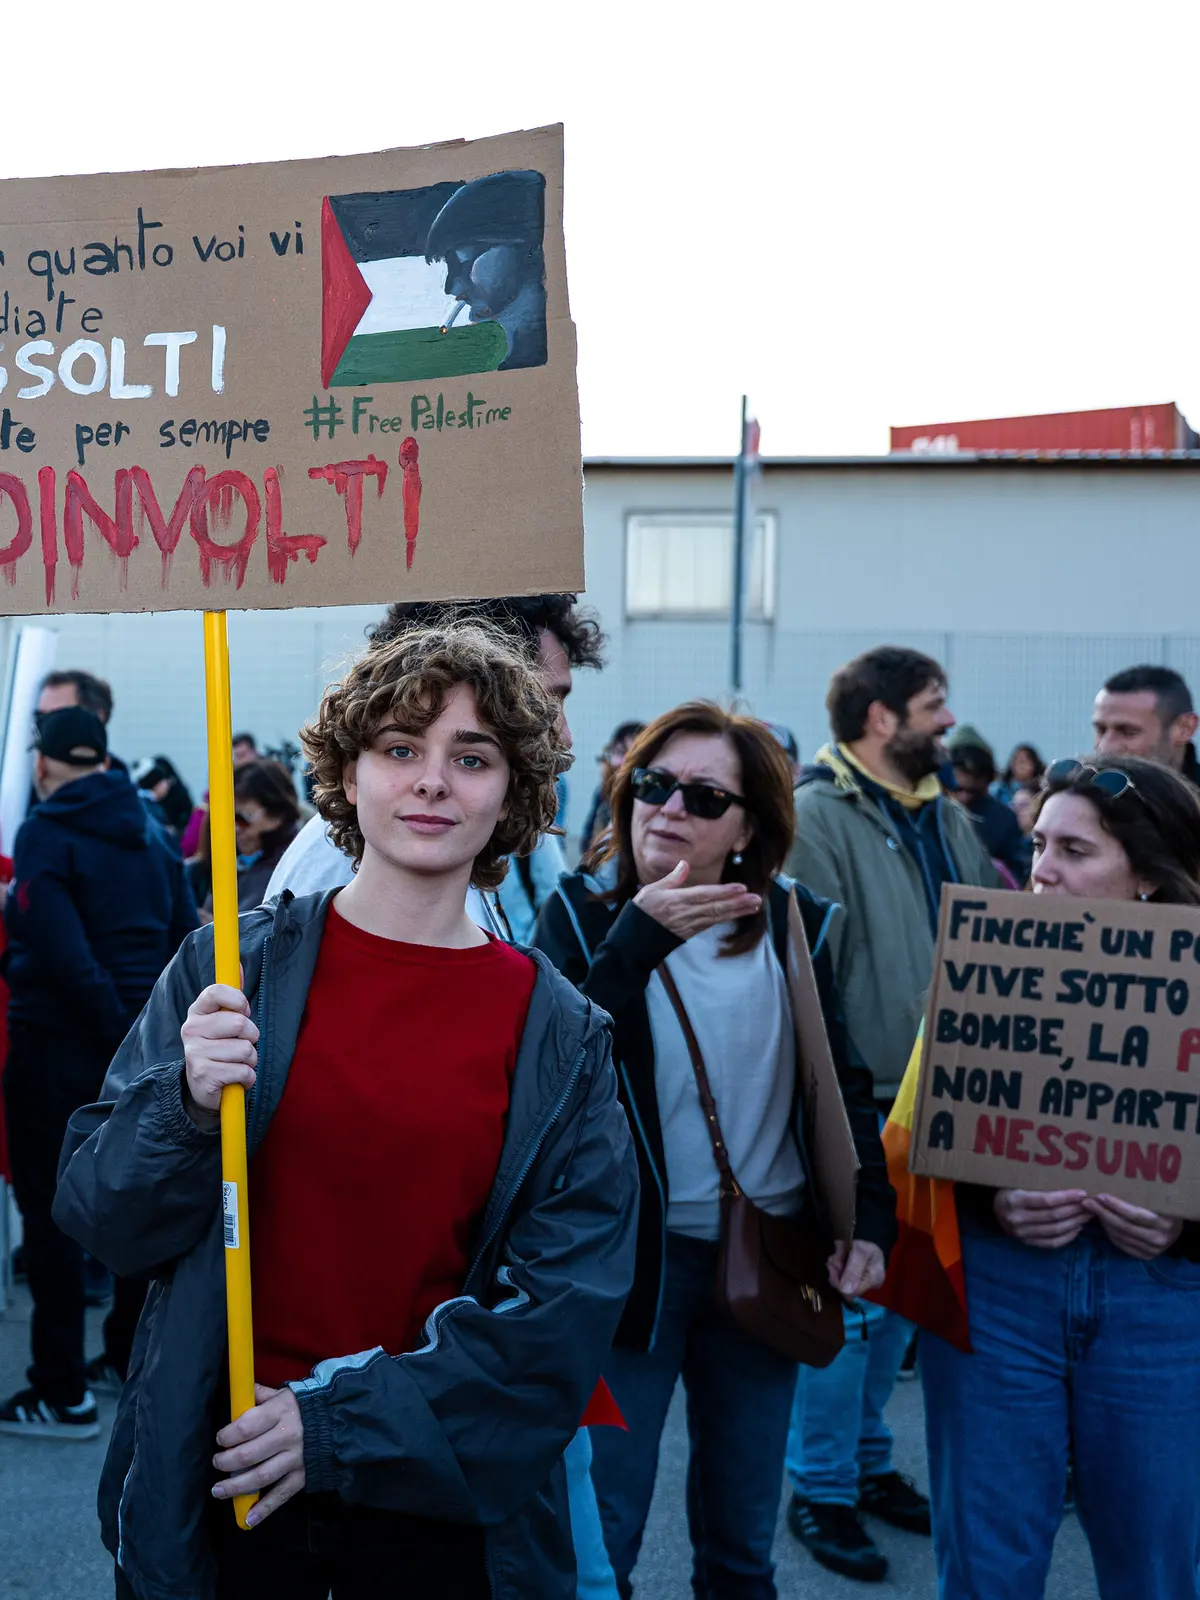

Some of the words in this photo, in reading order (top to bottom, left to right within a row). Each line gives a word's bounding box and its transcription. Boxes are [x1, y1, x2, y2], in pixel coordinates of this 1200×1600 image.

[28, 207, 174, 301] quanto
[191, 225, 245, 262] voi
[269, 221, 304, 257] vi
[76, 420, 131, 465] per
[159, 418, 271, 459] sempre
[1101, 927, 1154, 959] UN
[1169, 929, 1200, 964] P
[943, 960, 1044, 1001] VIVE
[1056, 969, 1189, 1016] SOTTO
[936, 1008, 1074, 1071] BOMBE,
[1086, 1023, 1149, 1068] LA
[932, 1065, 1022, 1110] NON
[927, 1110, 955, 1151] A
[972, 1114, 1182, 1184] NESSUNO
